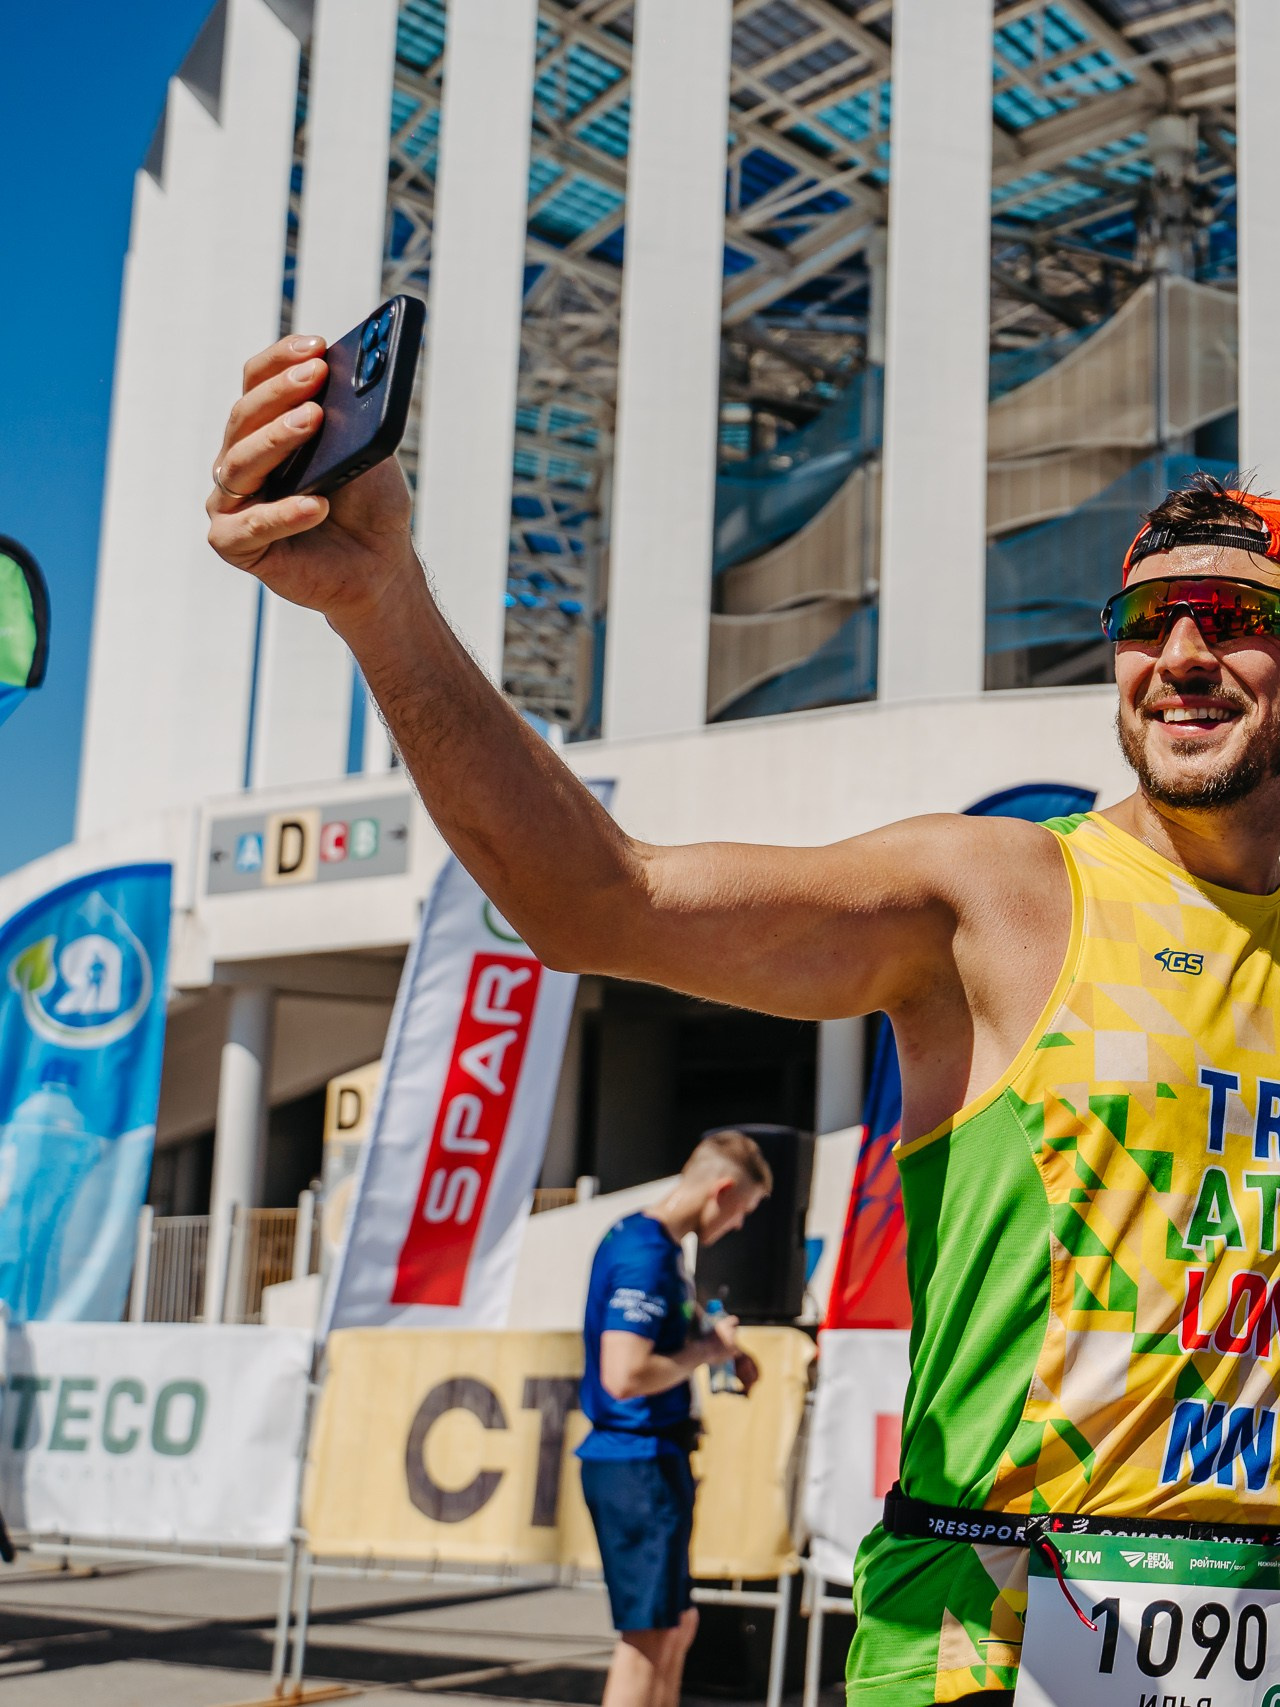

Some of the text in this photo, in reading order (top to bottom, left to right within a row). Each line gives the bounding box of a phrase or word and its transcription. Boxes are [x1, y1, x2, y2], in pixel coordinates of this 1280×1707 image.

[278, 822, 305, 874] D
[338, 1088, 361, 1130] D
[422, 963, 532, 1226] SPAR
[1158, 1397, 1279, 1495] NN
[1091, 1597, 1268, 1682] 1090
